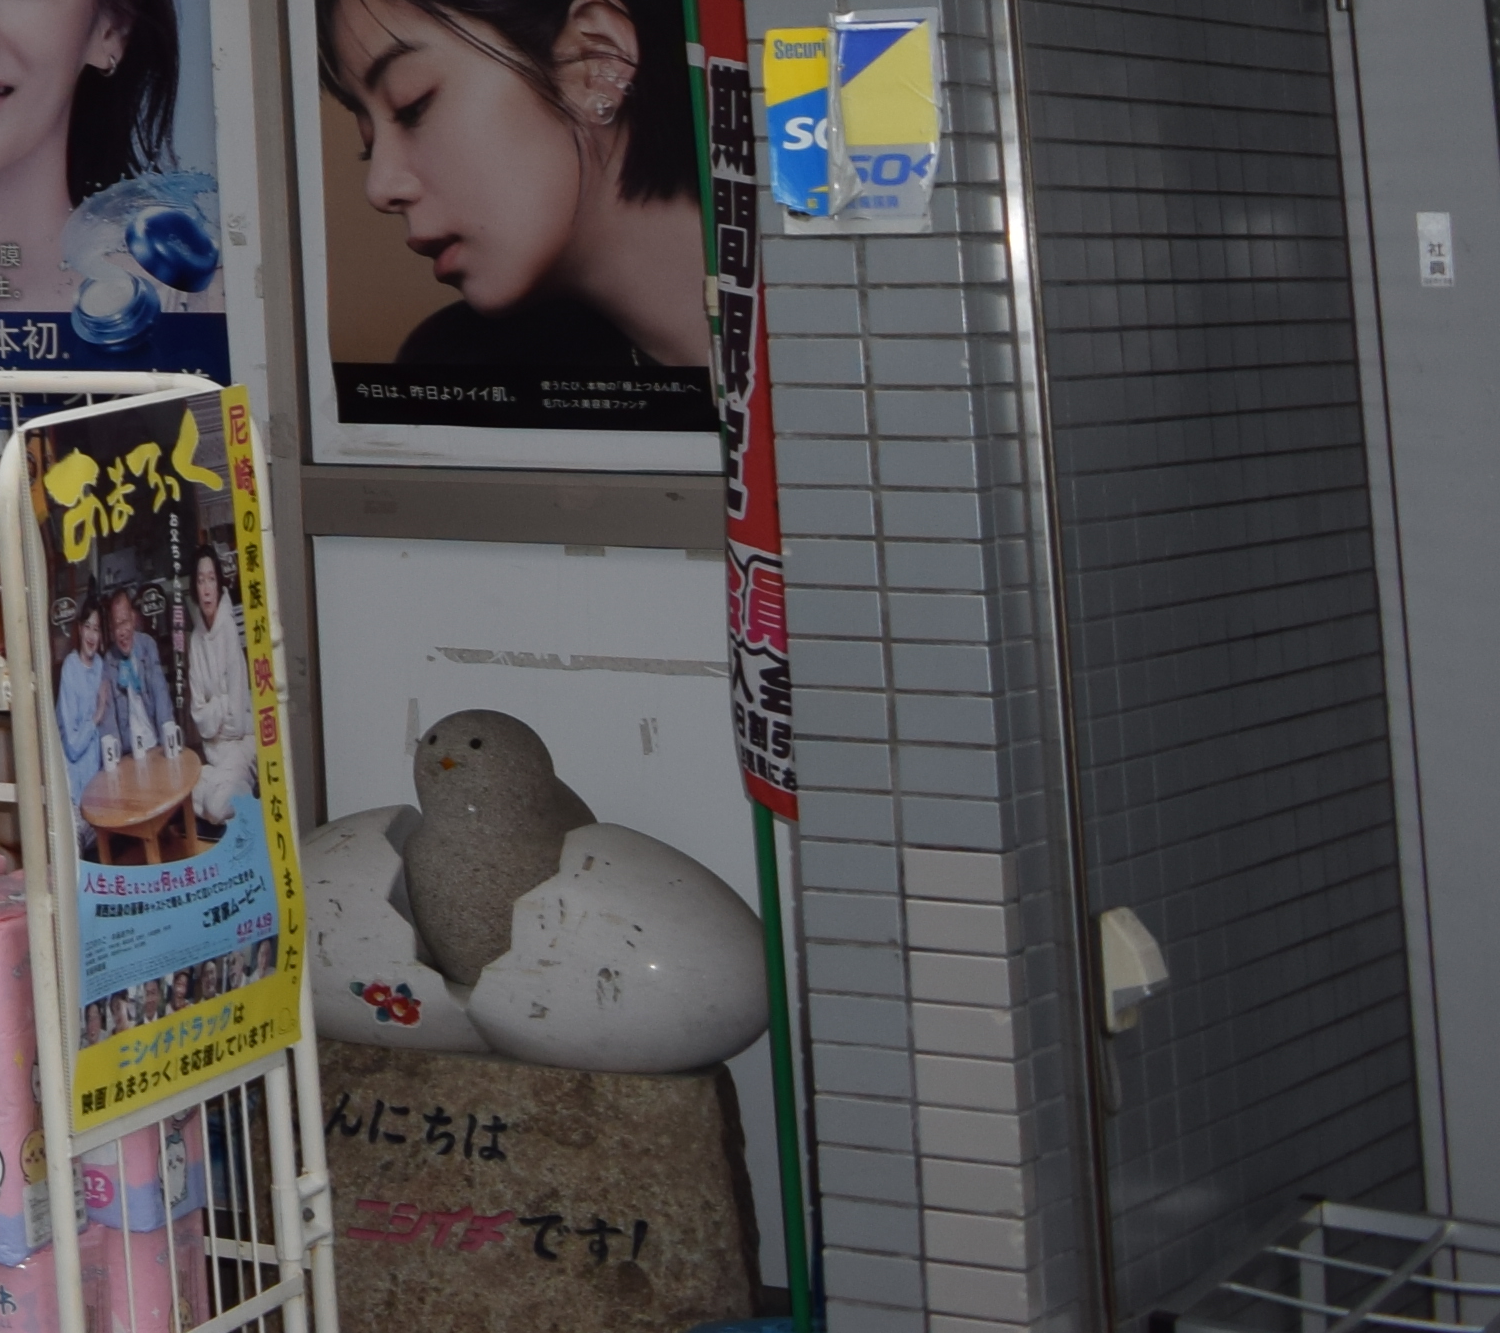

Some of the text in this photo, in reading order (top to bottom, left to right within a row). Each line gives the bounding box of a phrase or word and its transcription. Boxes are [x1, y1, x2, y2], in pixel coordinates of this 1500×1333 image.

[356, 383, 517, 403] 今日は、昨日よりイイ肌。
[226, 403, 300, 986] 尼崎の家族が映画になりました。
[118, 1001, 246, 1069] ニシイチドラッグは
